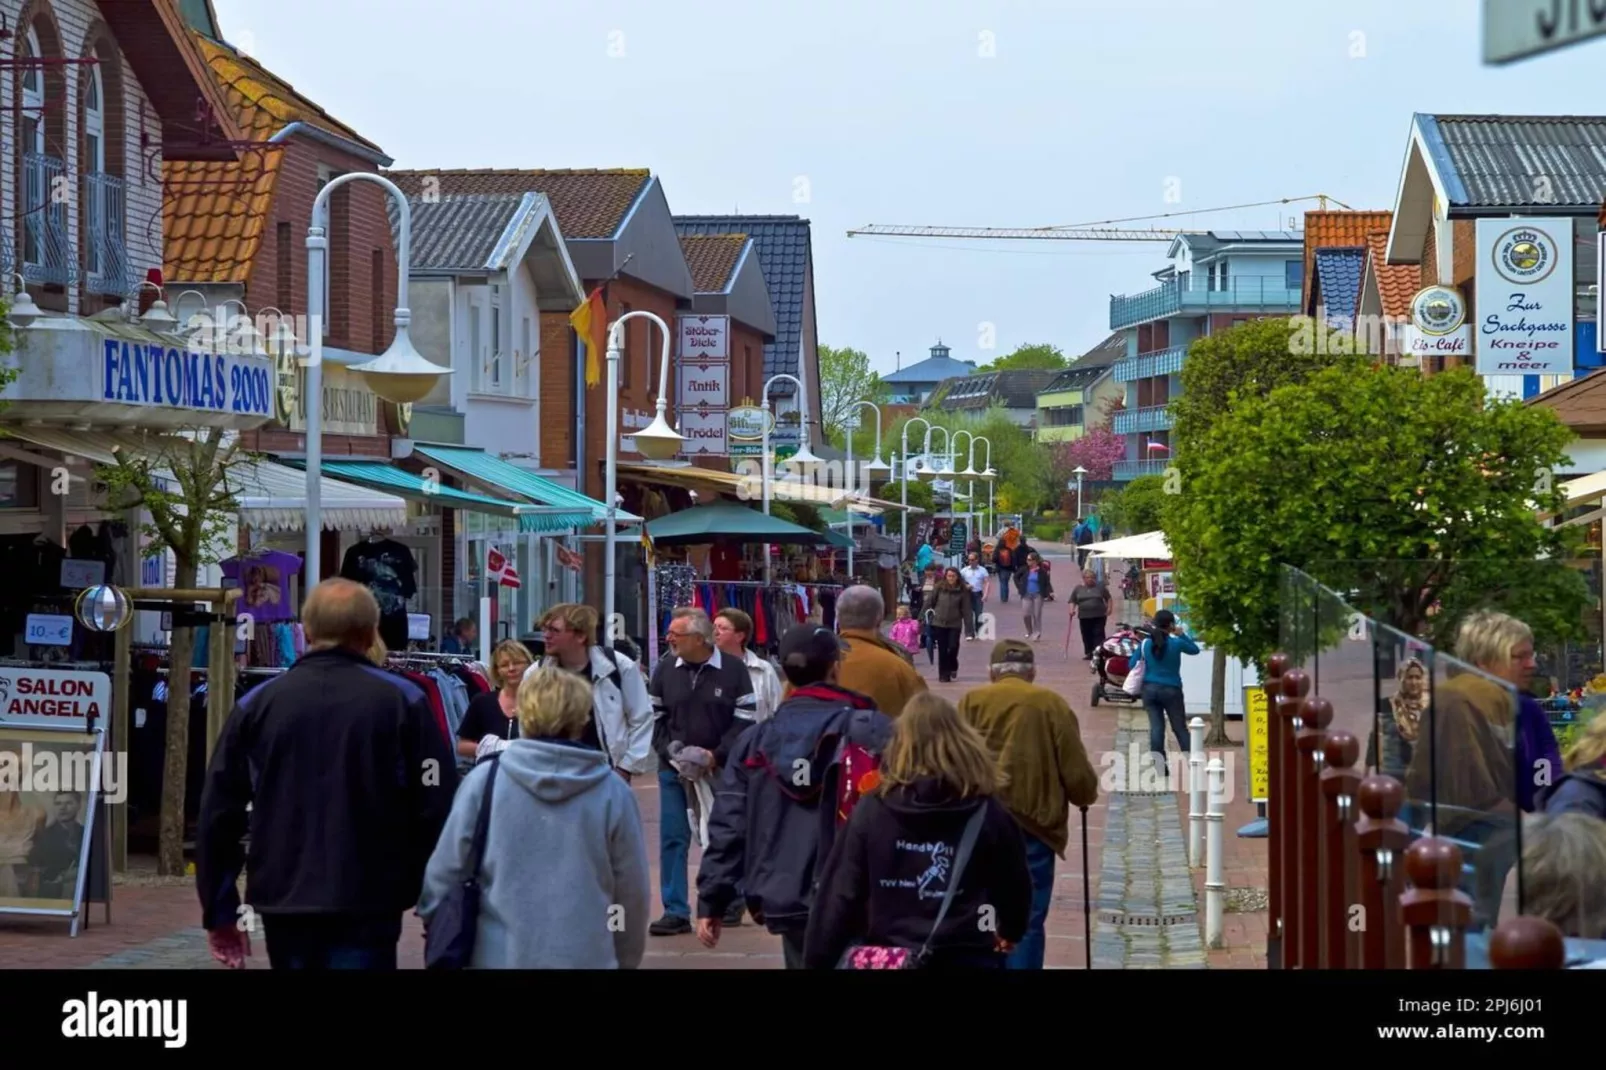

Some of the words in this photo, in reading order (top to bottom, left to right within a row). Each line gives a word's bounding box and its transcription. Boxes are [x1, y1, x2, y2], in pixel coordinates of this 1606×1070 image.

[1506, 293, 1542, 312] Zur
[1482, 314, 1568, 337] Sackgasse
[1412, 337, 1465, 353] Eis-Café
[1490, 338, 1560, 350] Kneipe
[1516, 351, 1532, 361] &
[1498, 362, 1552, 370] meer
[104, 338, 226, 410] FANTOMAS
[231, 364, 269, 415] 2000
[688, 380, 721, 392] Antik
[330, 387, 376, 424] RESTAURANT
[685, 428, 723, 439] Trödel
[58, 626, 69, 639] €
[17, 677, 94, 697] SALON
[8, 700, 100, 718] ANGELA
